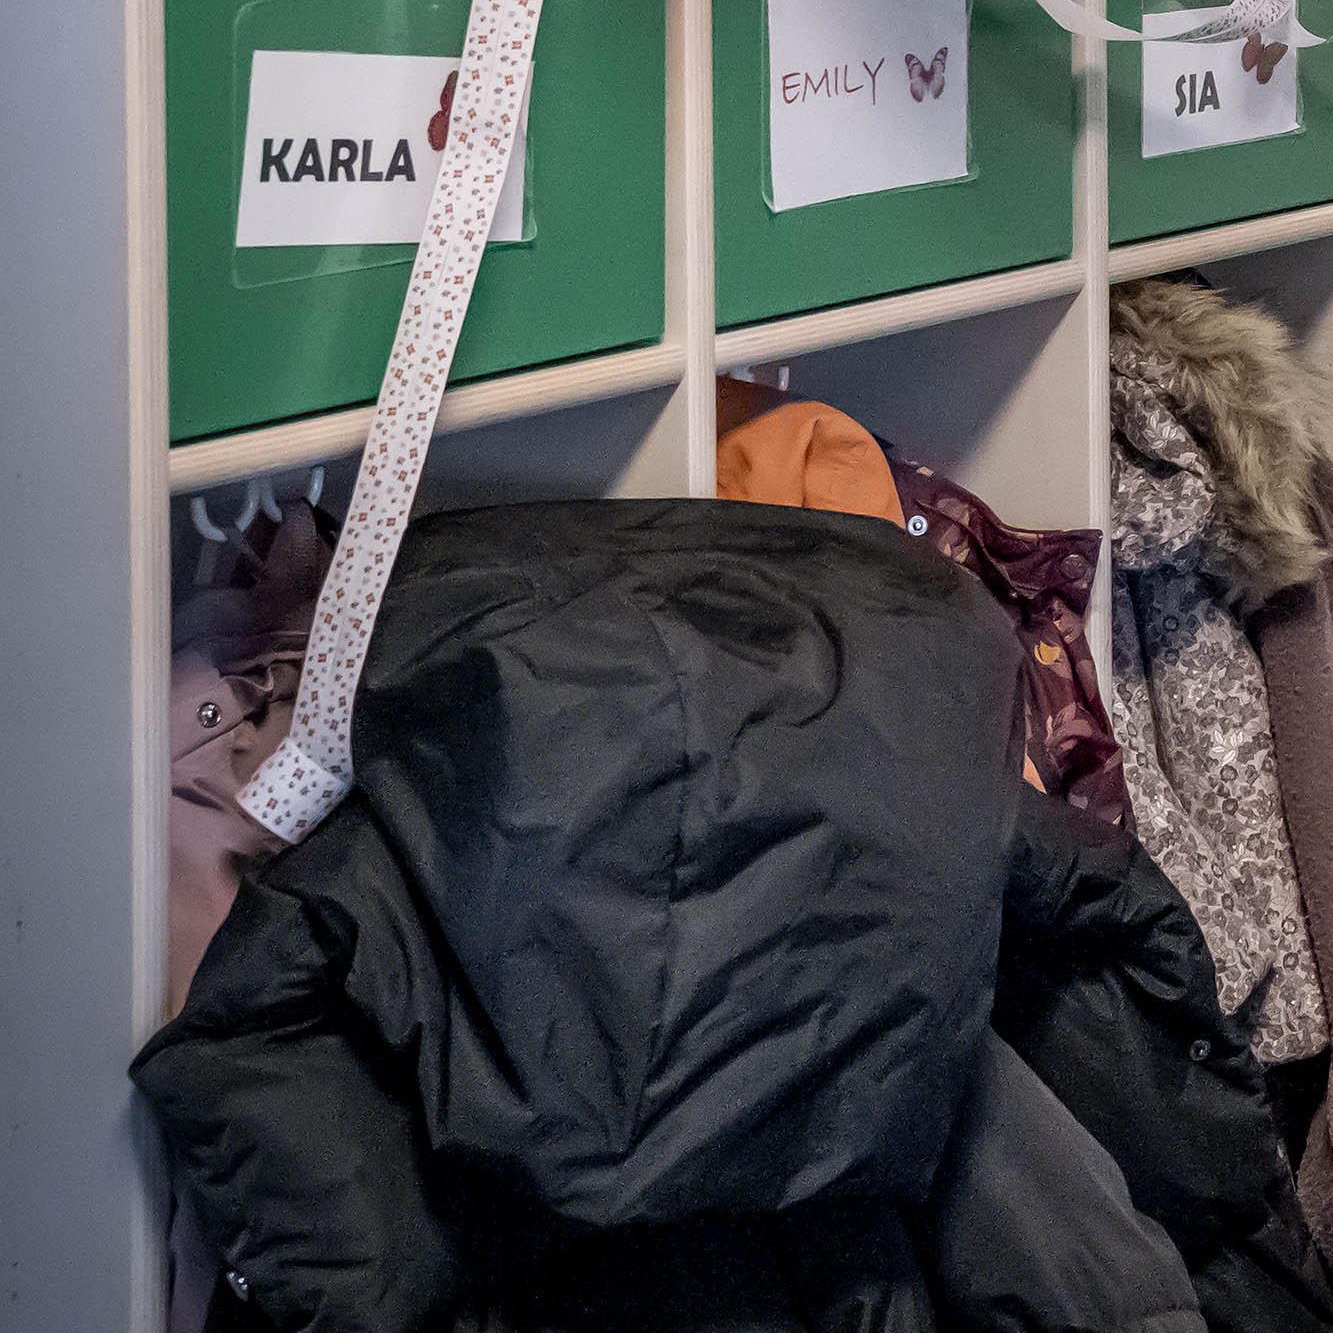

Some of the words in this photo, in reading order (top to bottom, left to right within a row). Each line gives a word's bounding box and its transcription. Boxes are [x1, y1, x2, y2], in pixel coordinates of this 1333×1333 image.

[781, 57, 886, 106] EMILY
[1174, 70, 1221, 118] SIA
[259, 137, 417, 183] KARLA
